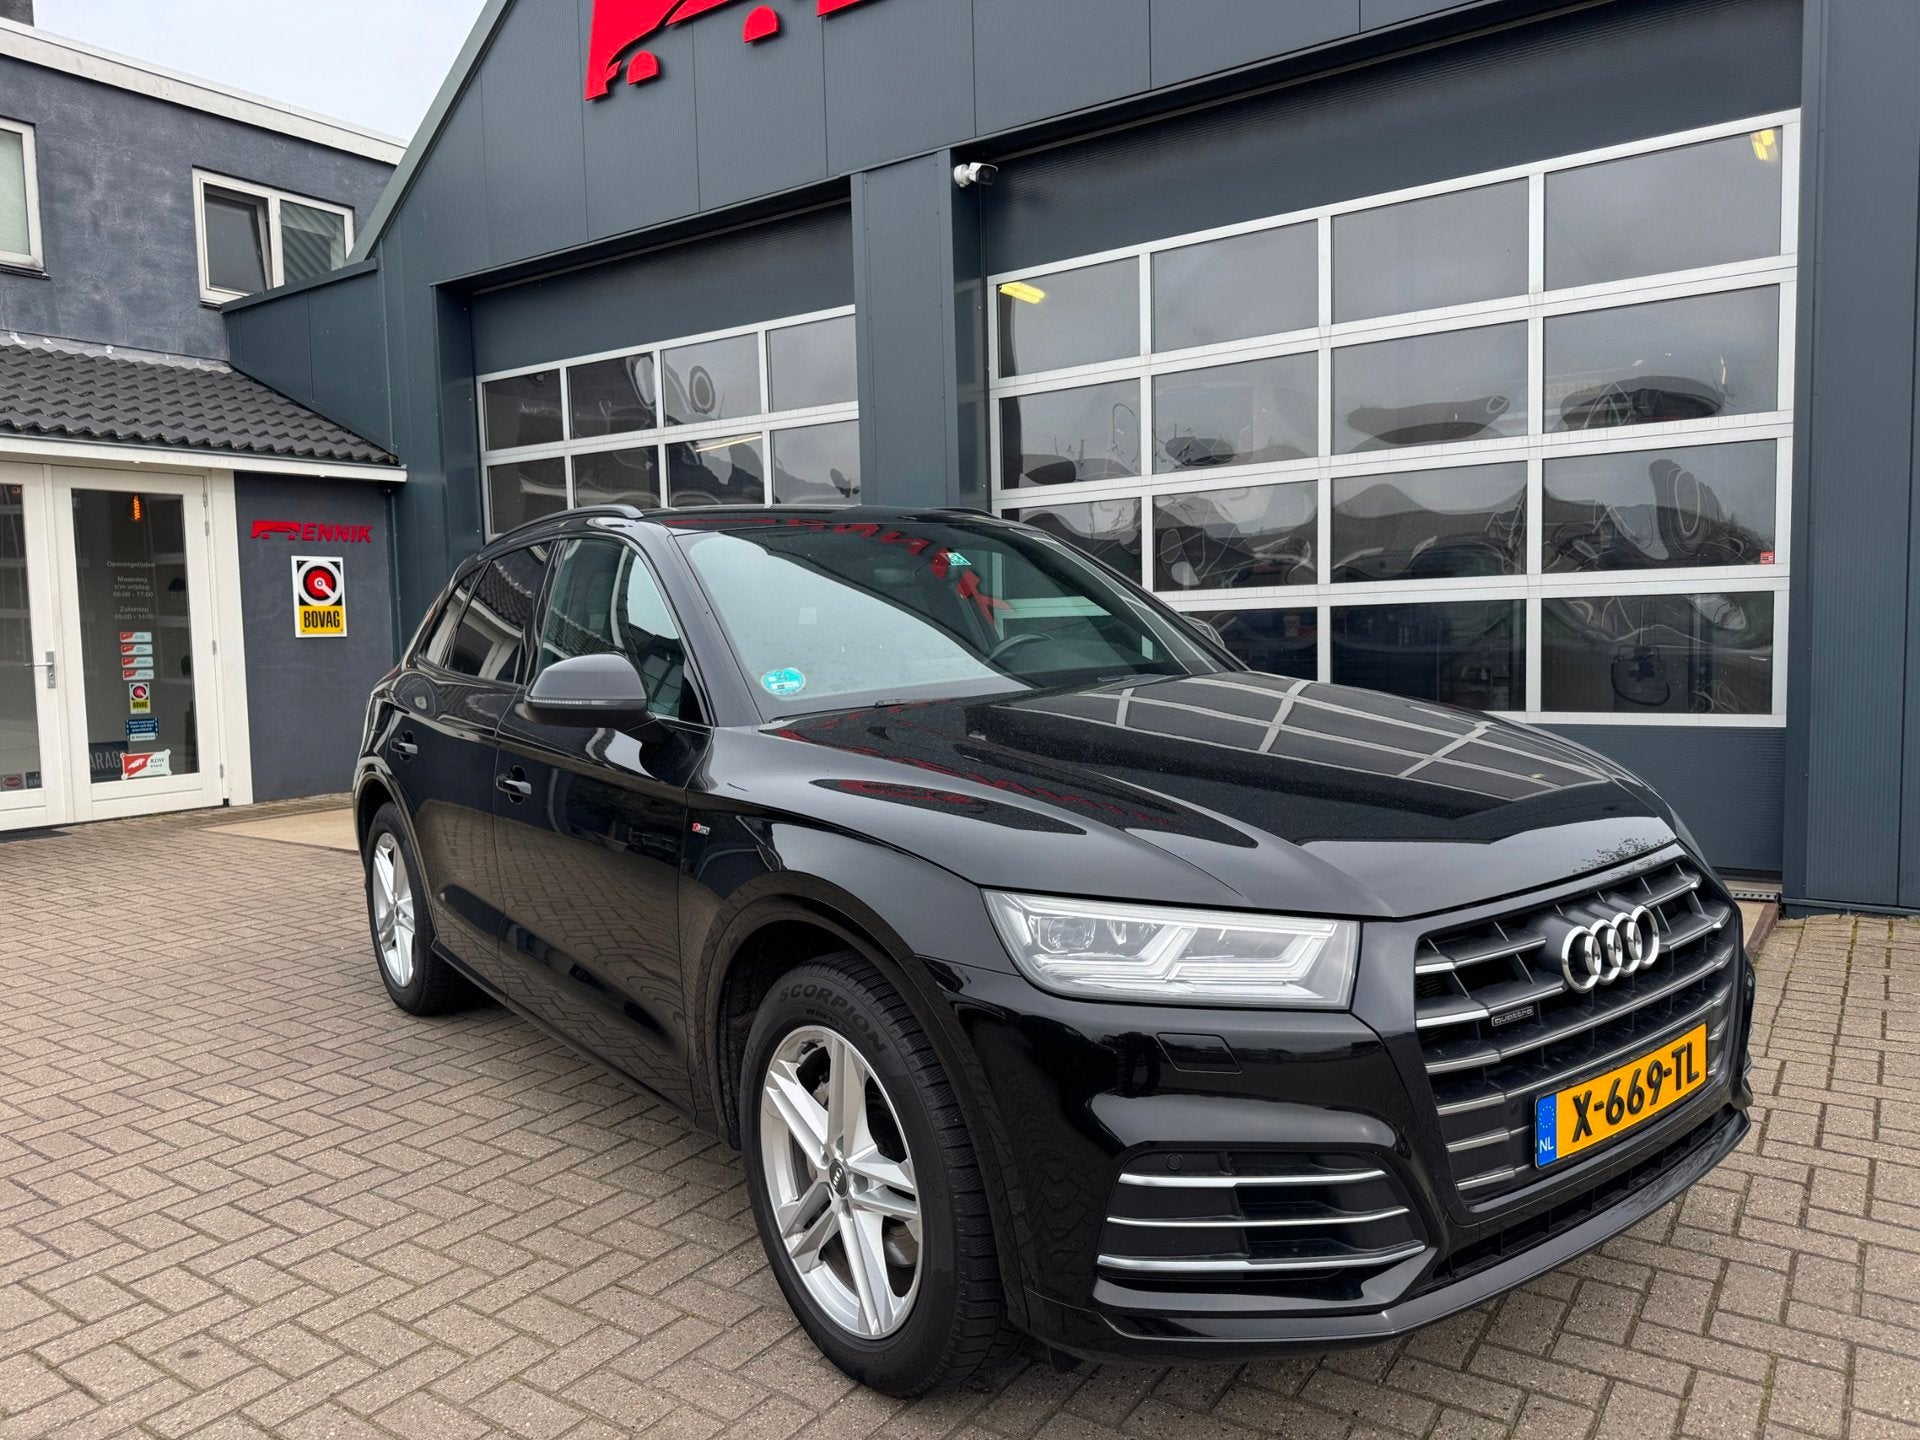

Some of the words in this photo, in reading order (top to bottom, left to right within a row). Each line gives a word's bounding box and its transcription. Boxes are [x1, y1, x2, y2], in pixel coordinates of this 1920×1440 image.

[303, 610, 340, 629] BOVAG
[89, 750, 122, 770] ARAG
[778, 983, 889, 1054] SCORPION
[1494, 1008, 1533, 1026] quattro
[1571, 1041, 1700, 1143] X-669-TL
[1539, 1136, 1555, 1154] NL
